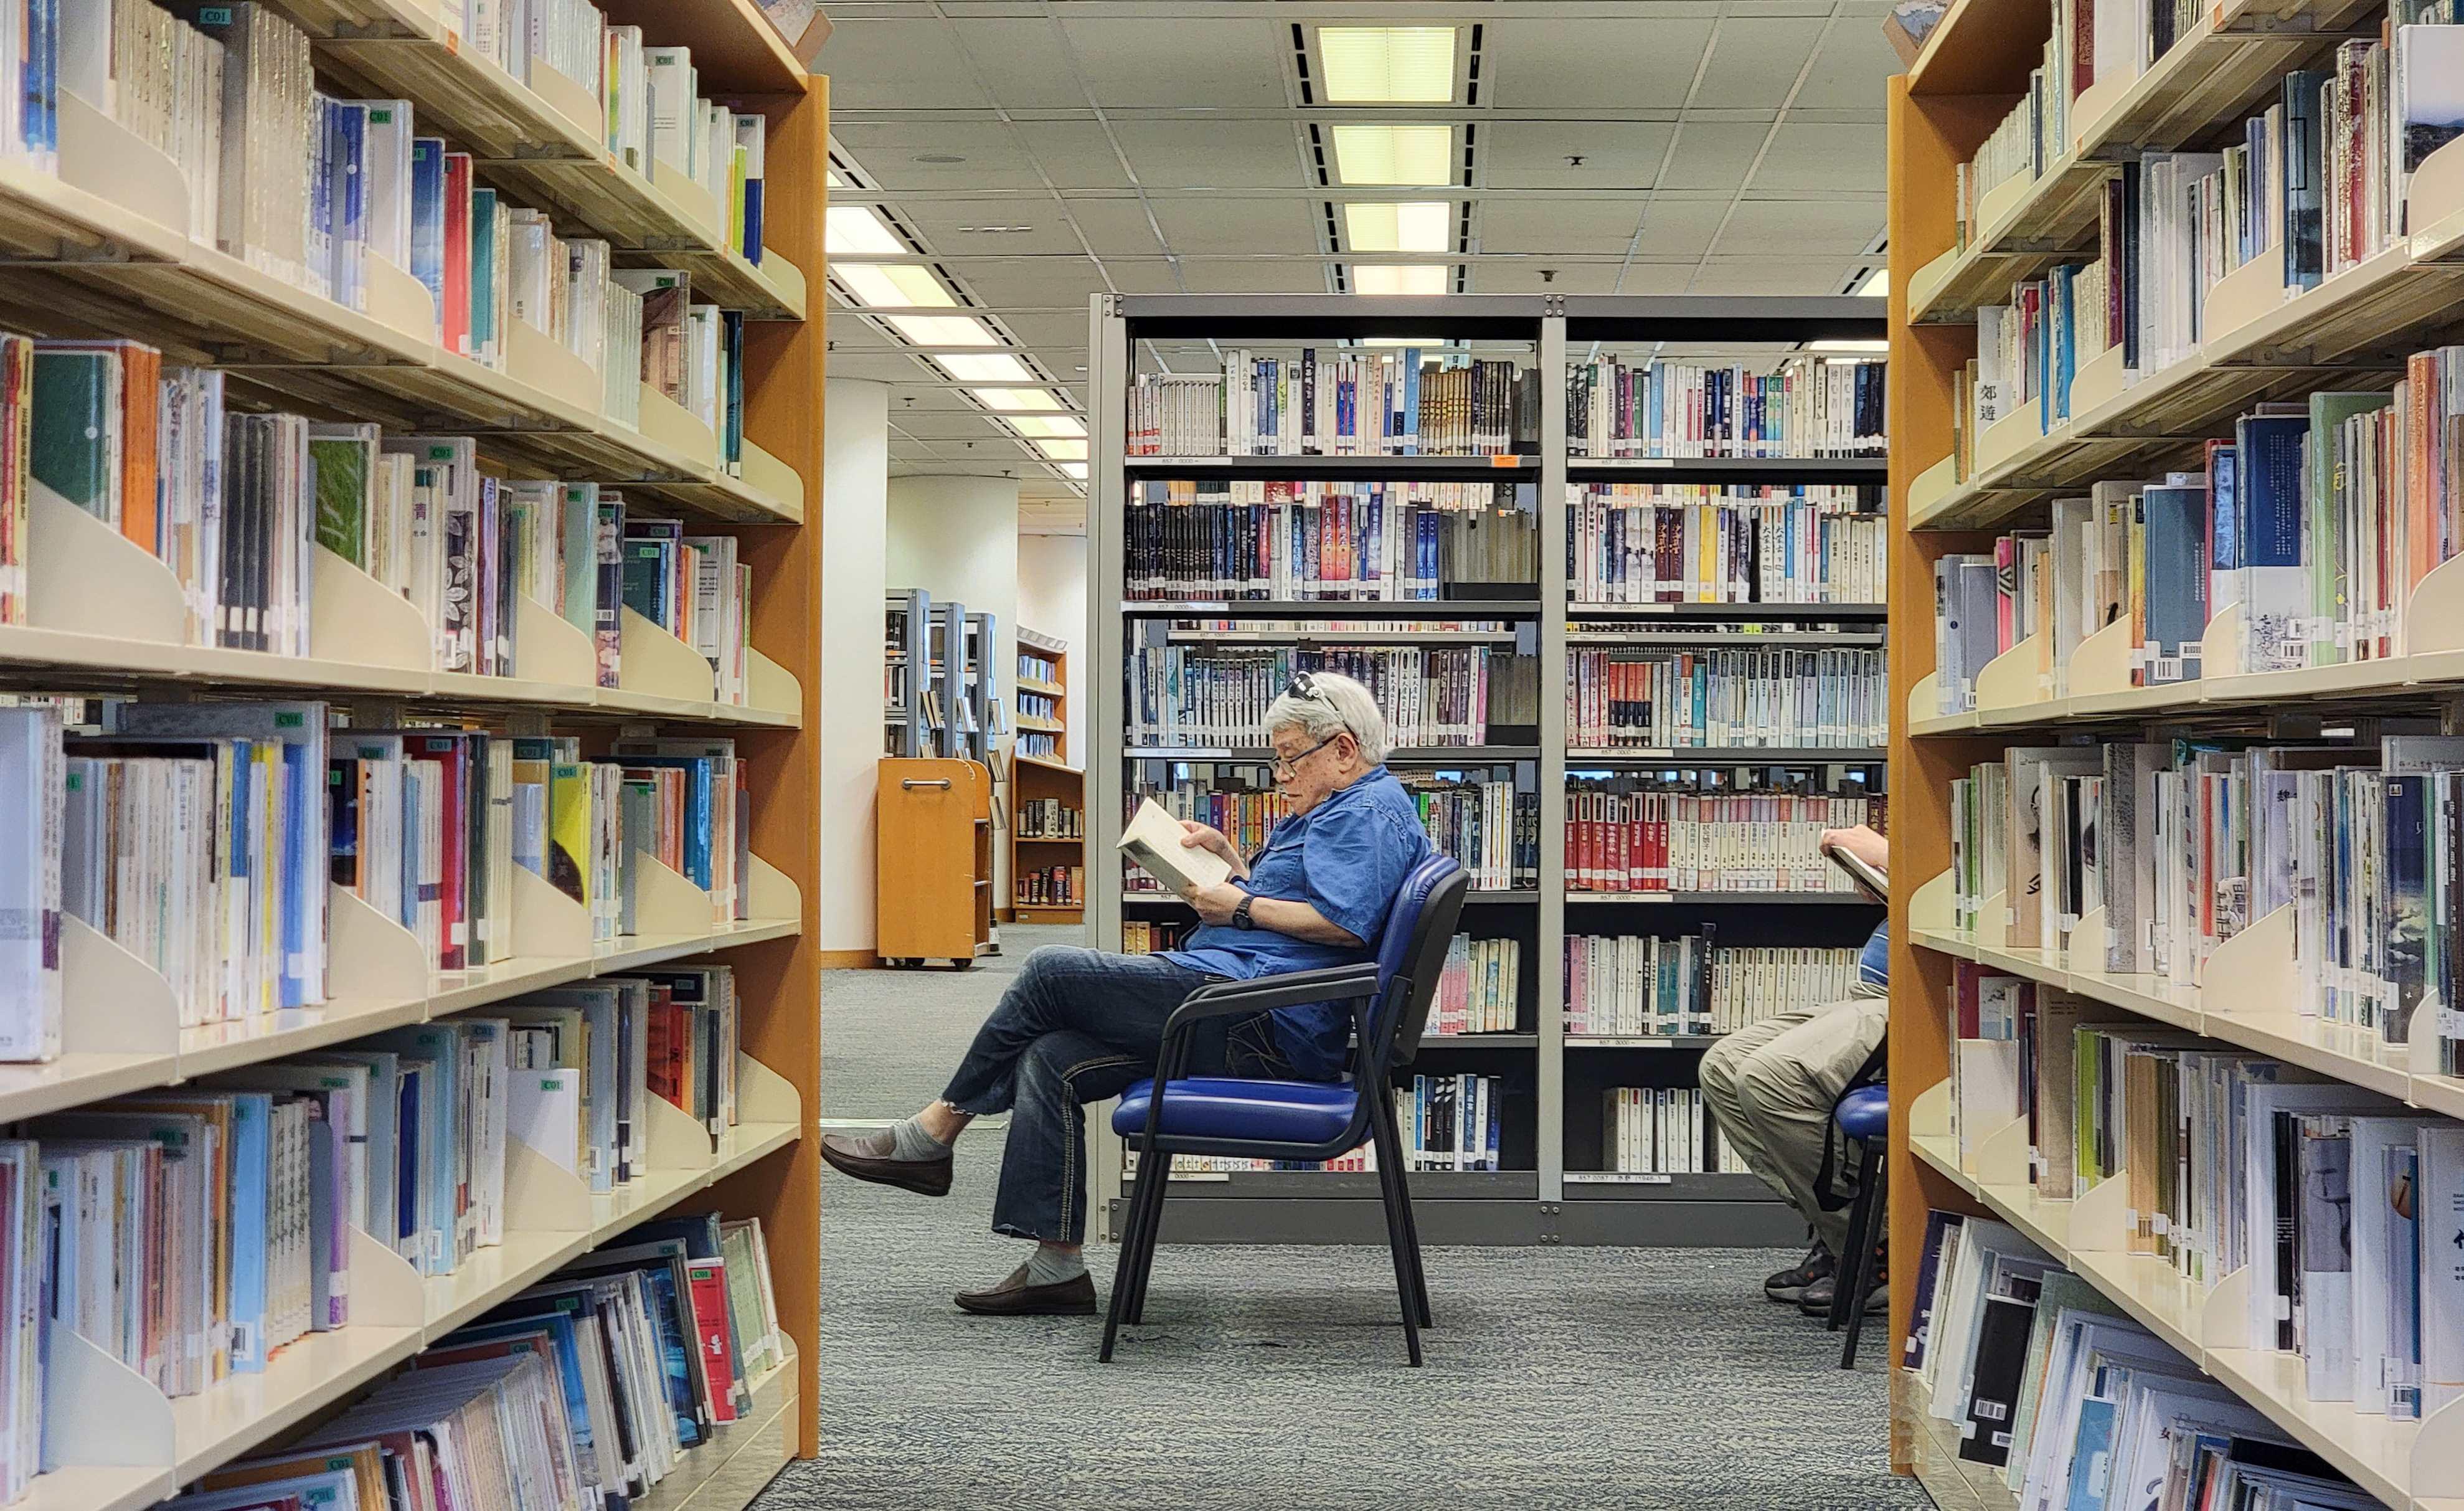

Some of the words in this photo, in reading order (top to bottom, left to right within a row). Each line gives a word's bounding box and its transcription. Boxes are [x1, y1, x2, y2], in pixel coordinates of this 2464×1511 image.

[205, 11, 225, 22] C01
[656, 57, 673, 65] C01
[370, 111, 389, 122] C01
[740, 118, 754, 126] C01
[1980, 385, 1996, 420] 郊遊
[432, 447, 451, 457] C01
[430, 740, 447, 749] C01
[557, 767, 574, 777] C01
[544, 1081, 560, 1090] C01
